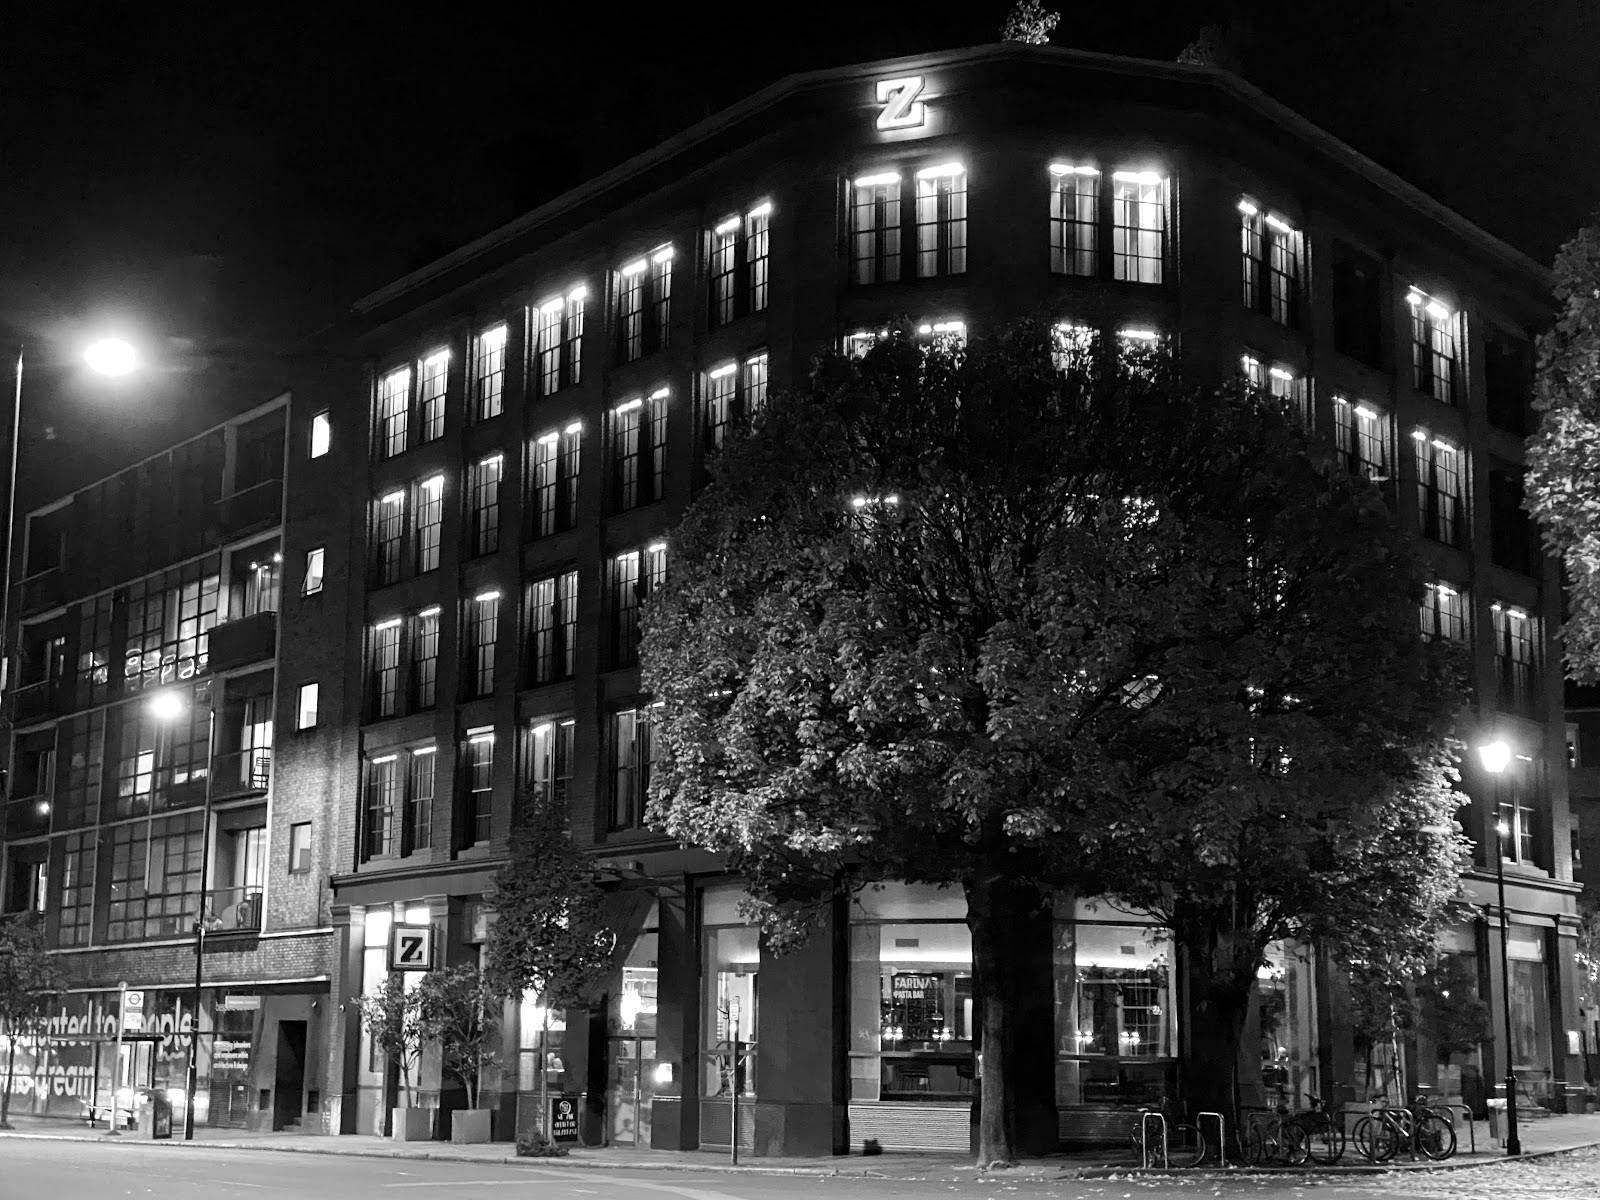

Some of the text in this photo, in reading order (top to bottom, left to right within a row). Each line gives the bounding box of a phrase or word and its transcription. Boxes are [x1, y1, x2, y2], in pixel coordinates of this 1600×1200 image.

[876, 76, 925, 132] Z
[401, 937, 423, 962] Z
[893, 990, 924, 999] PASTA BAR
[895, 977, 932, 989] FARINA
[124, 997, 192, 1062] eople
[36, 1051, 95, 1097] dream
